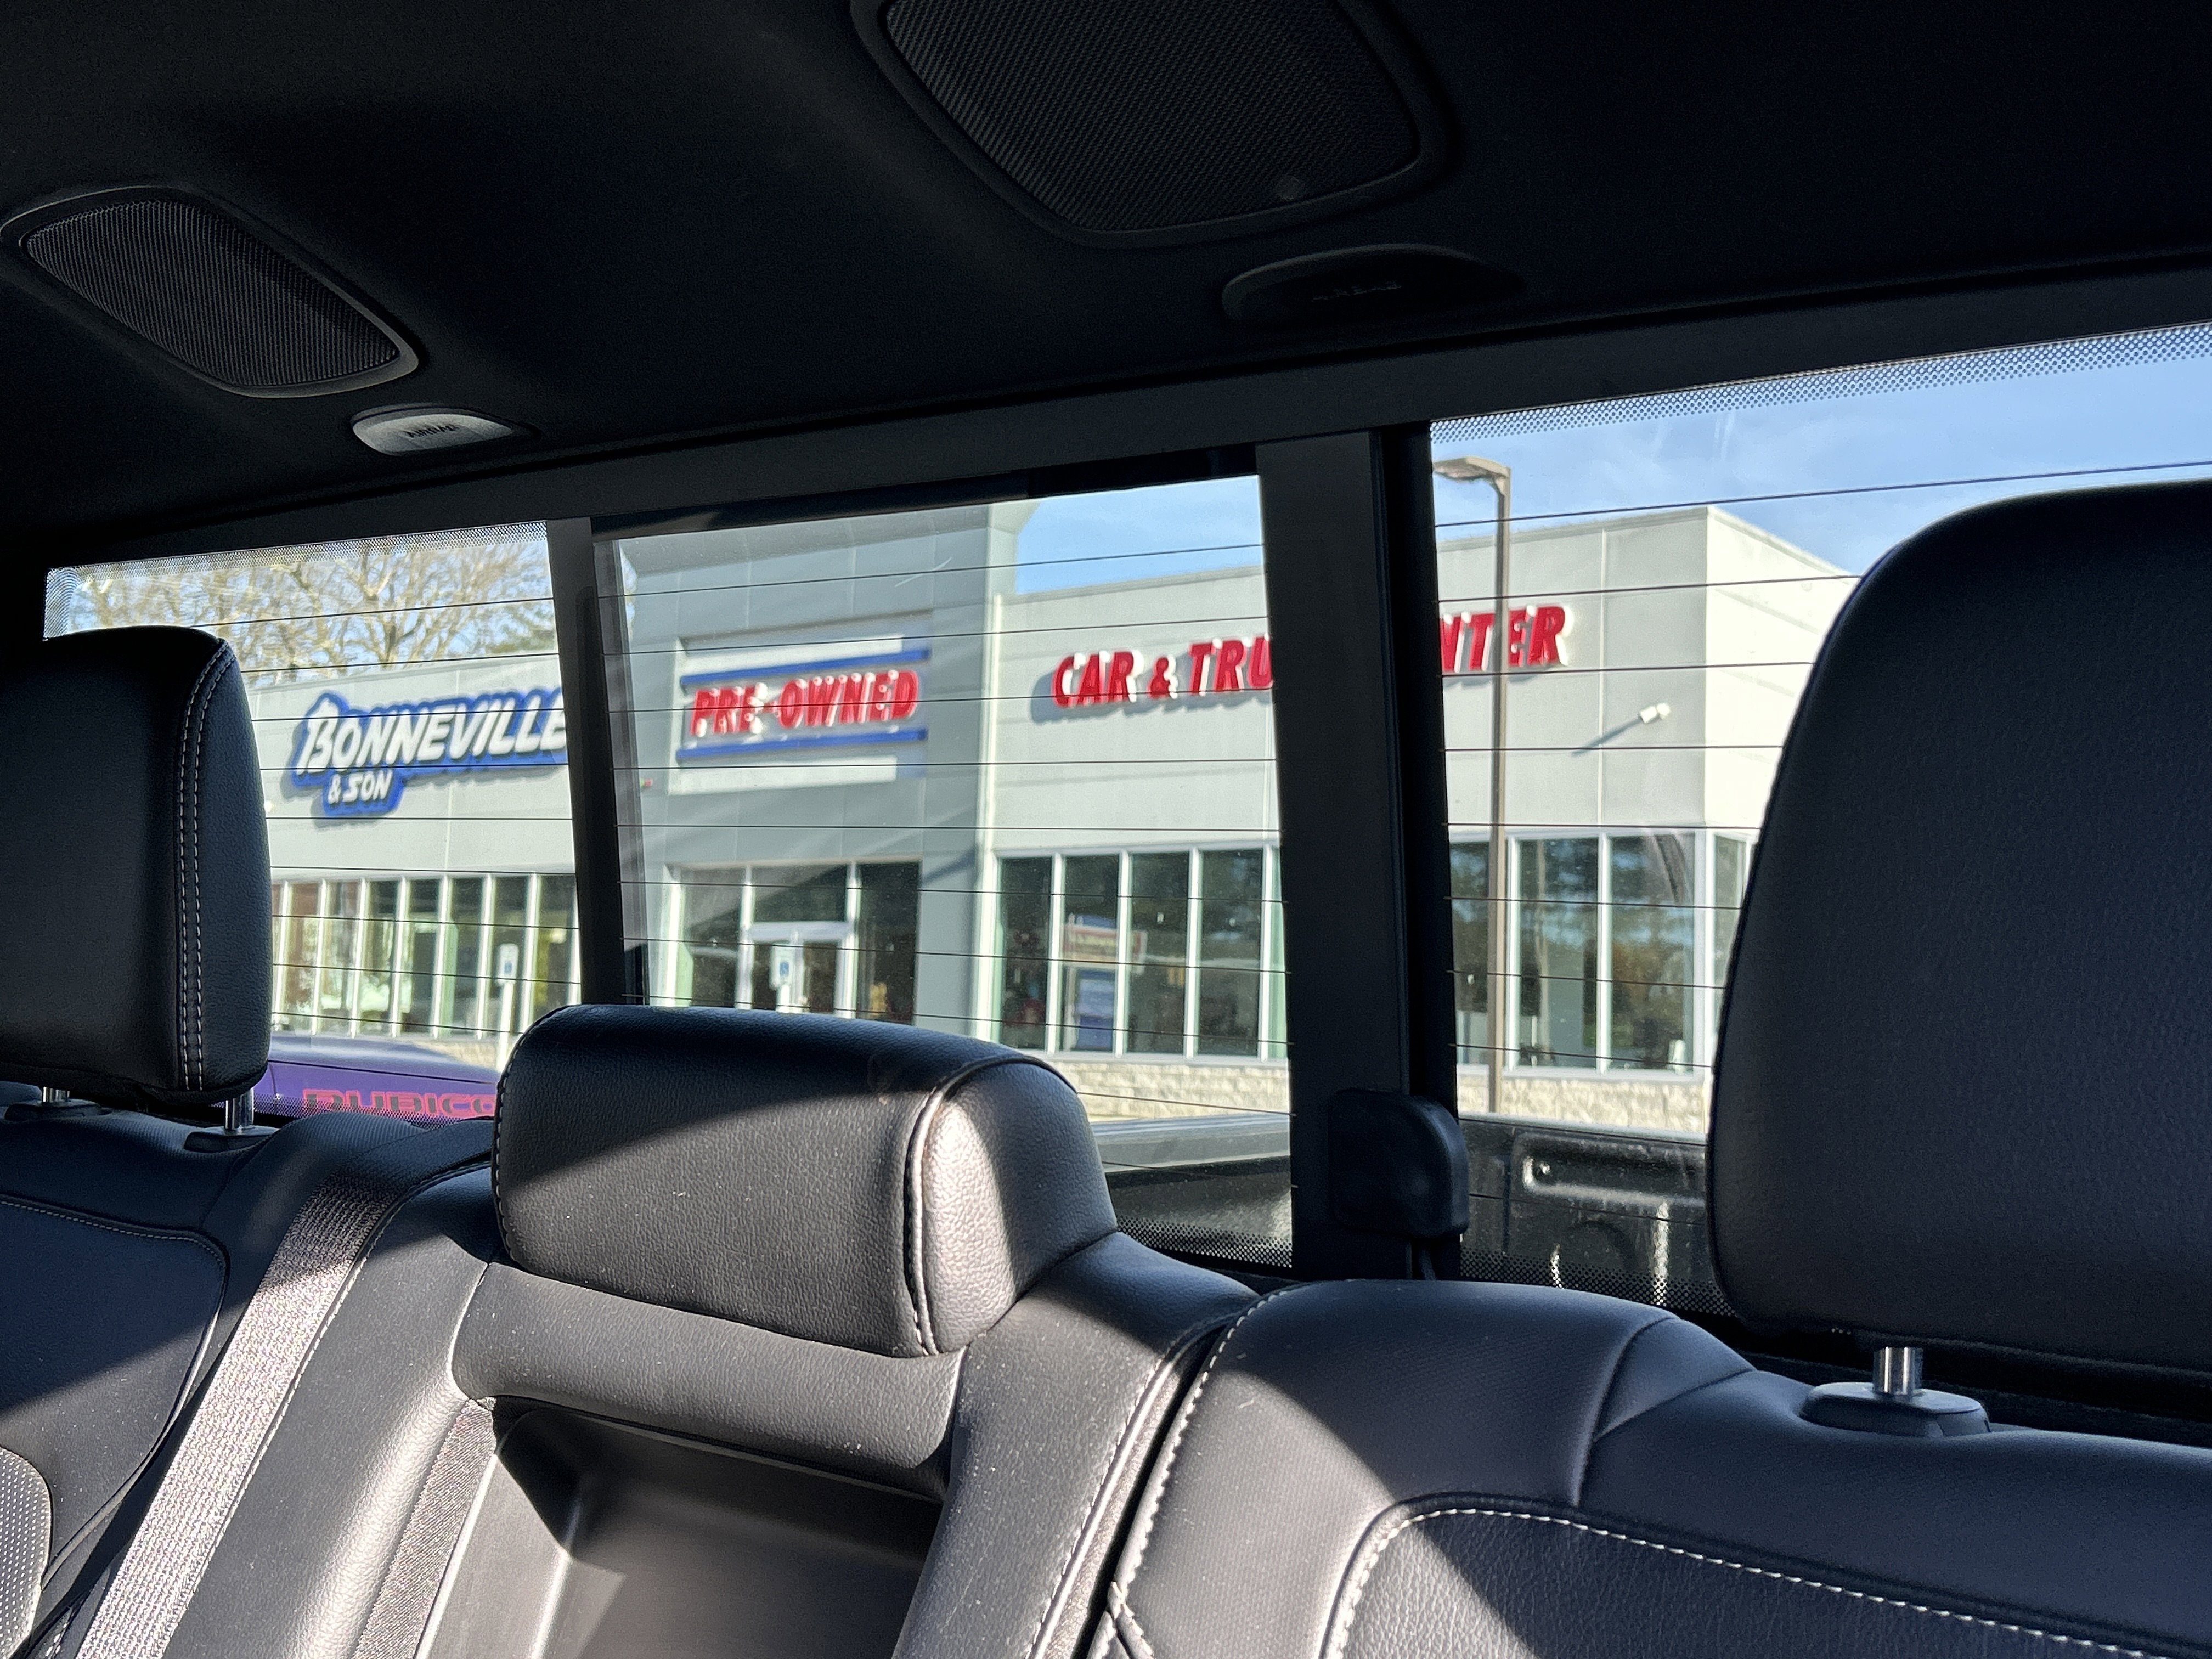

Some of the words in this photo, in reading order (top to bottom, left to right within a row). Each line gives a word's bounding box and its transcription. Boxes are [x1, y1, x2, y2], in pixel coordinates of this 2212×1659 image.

[1052, 650, 1143, 707] CAR
[1148, 656, 1178, 699] &
[1189, 633, 1273, 696] TRU
[1440, 605, 1573, 673] NTER
[296, 692, 567, 775] BONNEVILLE
[690, 670, 918, 736] PRE-OWNED
[328, 774, 339, 804] &
[342, 769, 394, 803] SON
[302, 1088, 496, 1117] RUBICO
